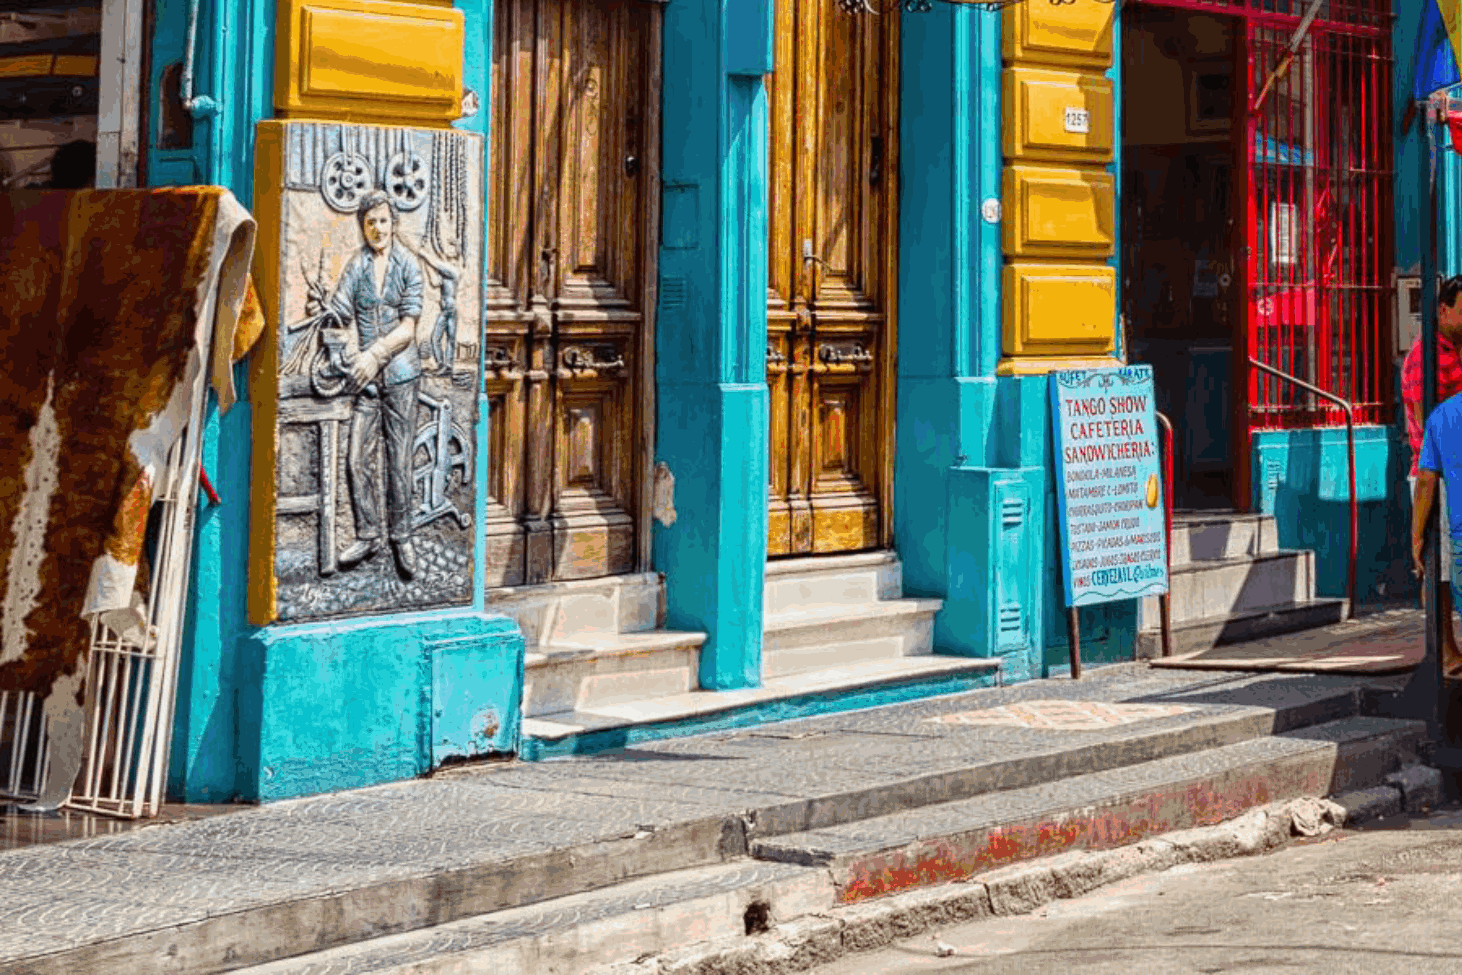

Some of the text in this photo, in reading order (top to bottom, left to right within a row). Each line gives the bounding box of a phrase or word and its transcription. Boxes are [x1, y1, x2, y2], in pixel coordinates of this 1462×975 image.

[1065, 395, 1147, 417] TANGO SHOW
[1070, 419, 1144, 440] CAFETERIA
